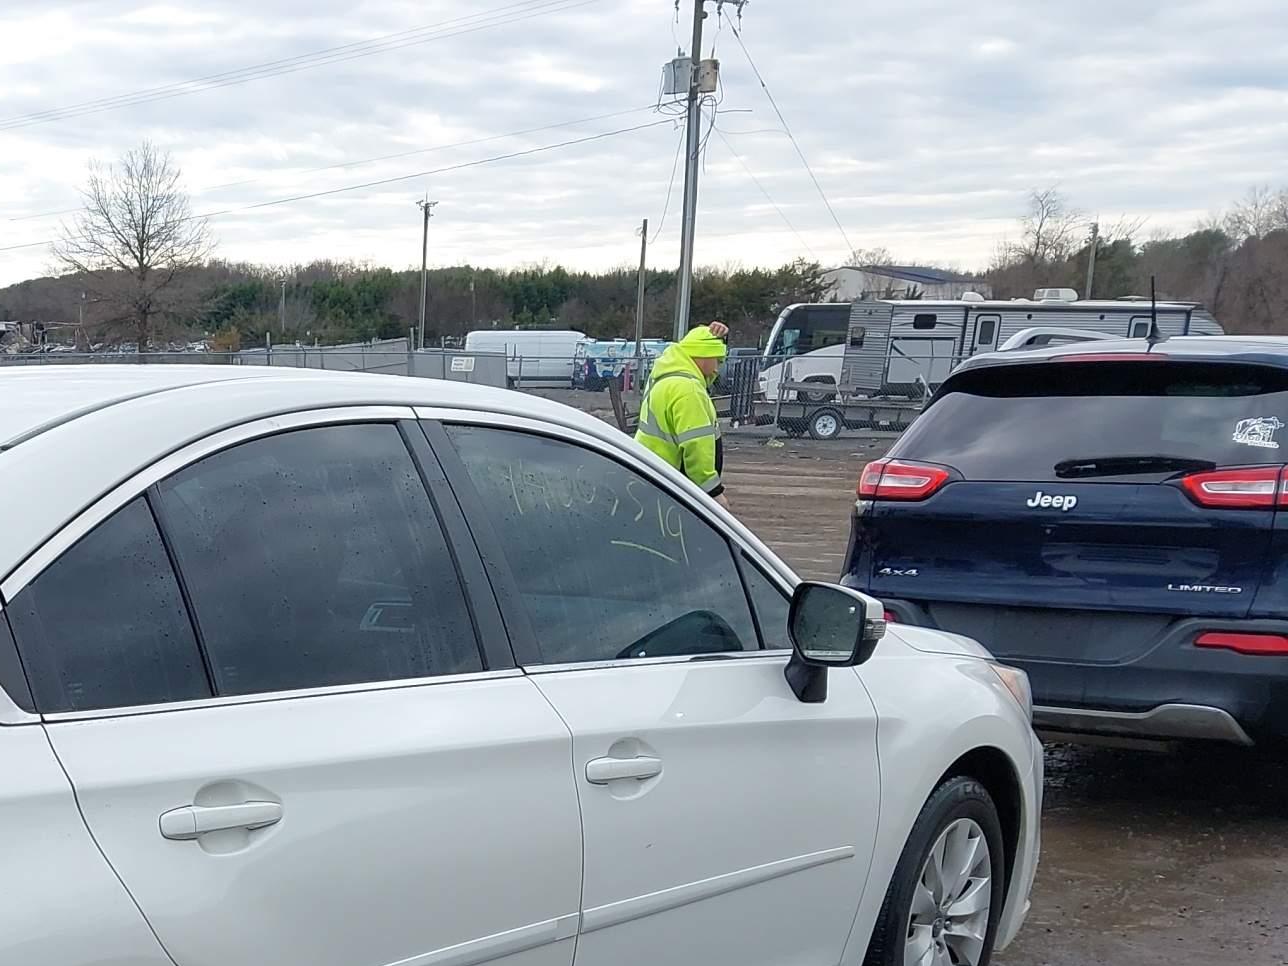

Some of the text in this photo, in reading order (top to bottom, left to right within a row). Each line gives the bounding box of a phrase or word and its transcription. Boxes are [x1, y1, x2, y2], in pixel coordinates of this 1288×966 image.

[1027, 491, 1077, 511] Jeep
[879, 567, 919, 577] 4x4
[1167, 584, 1242, 594] LIMITED
